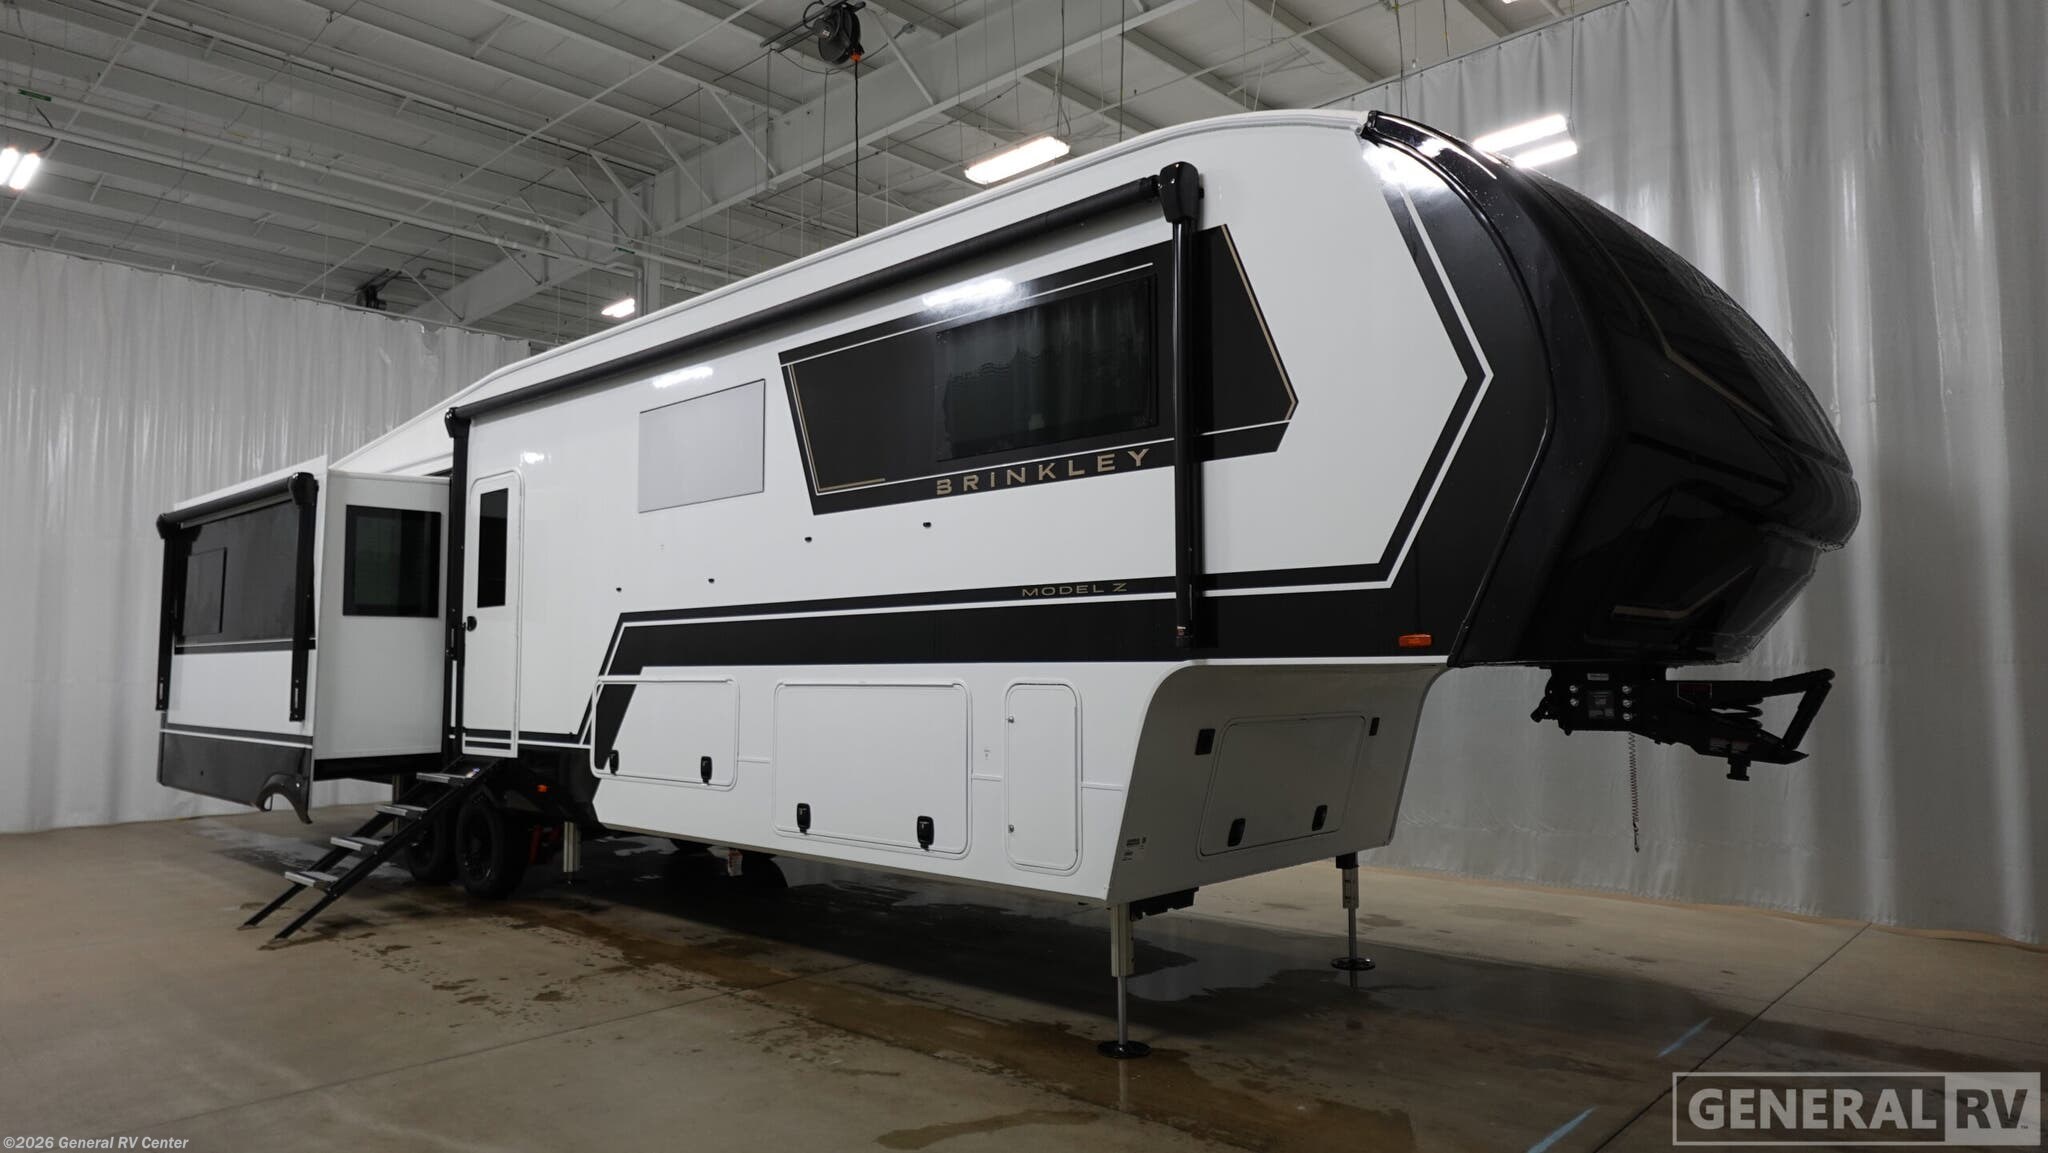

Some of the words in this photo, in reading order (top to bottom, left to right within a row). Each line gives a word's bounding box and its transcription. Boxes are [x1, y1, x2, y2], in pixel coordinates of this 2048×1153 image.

[936, 448, 1150, 496] BRINKLEY
[1022, 582, 1105, 598] MODEL
[1113, 582, 1128, 593] Z
